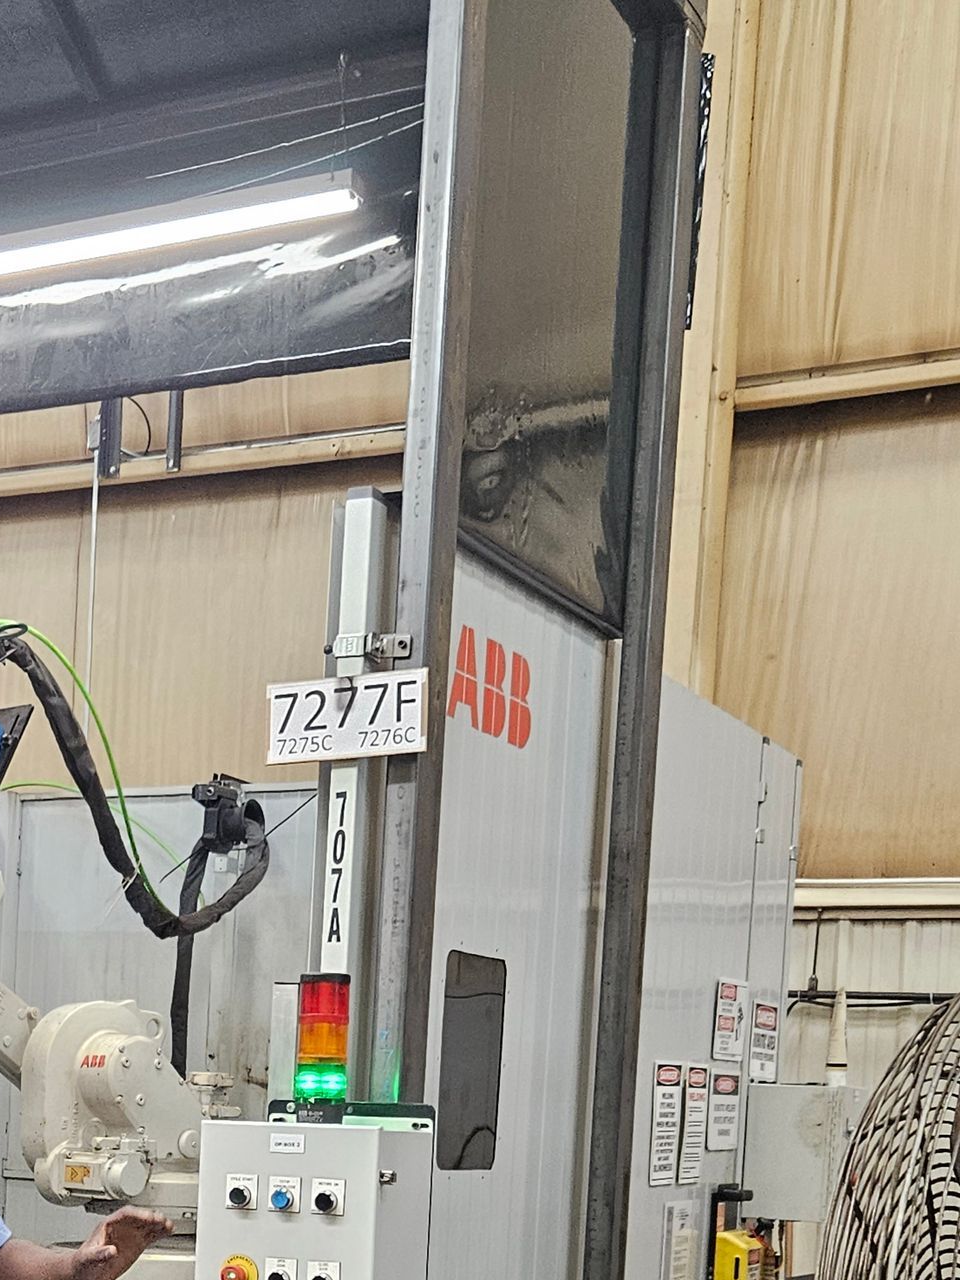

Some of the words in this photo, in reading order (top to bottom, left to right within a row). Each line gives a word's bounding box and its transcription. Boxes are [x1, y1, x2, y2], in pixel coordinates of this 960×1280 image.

[274, 680, 417, 735] 7277F
[447, 624, 531, 749] ABB
[277, 735, 333, 756] 7275C
[358, 727, 416, 748] 7276C
[327, 791, 348, 943] 707A
[80, 1055, 106, 1068] ABB
